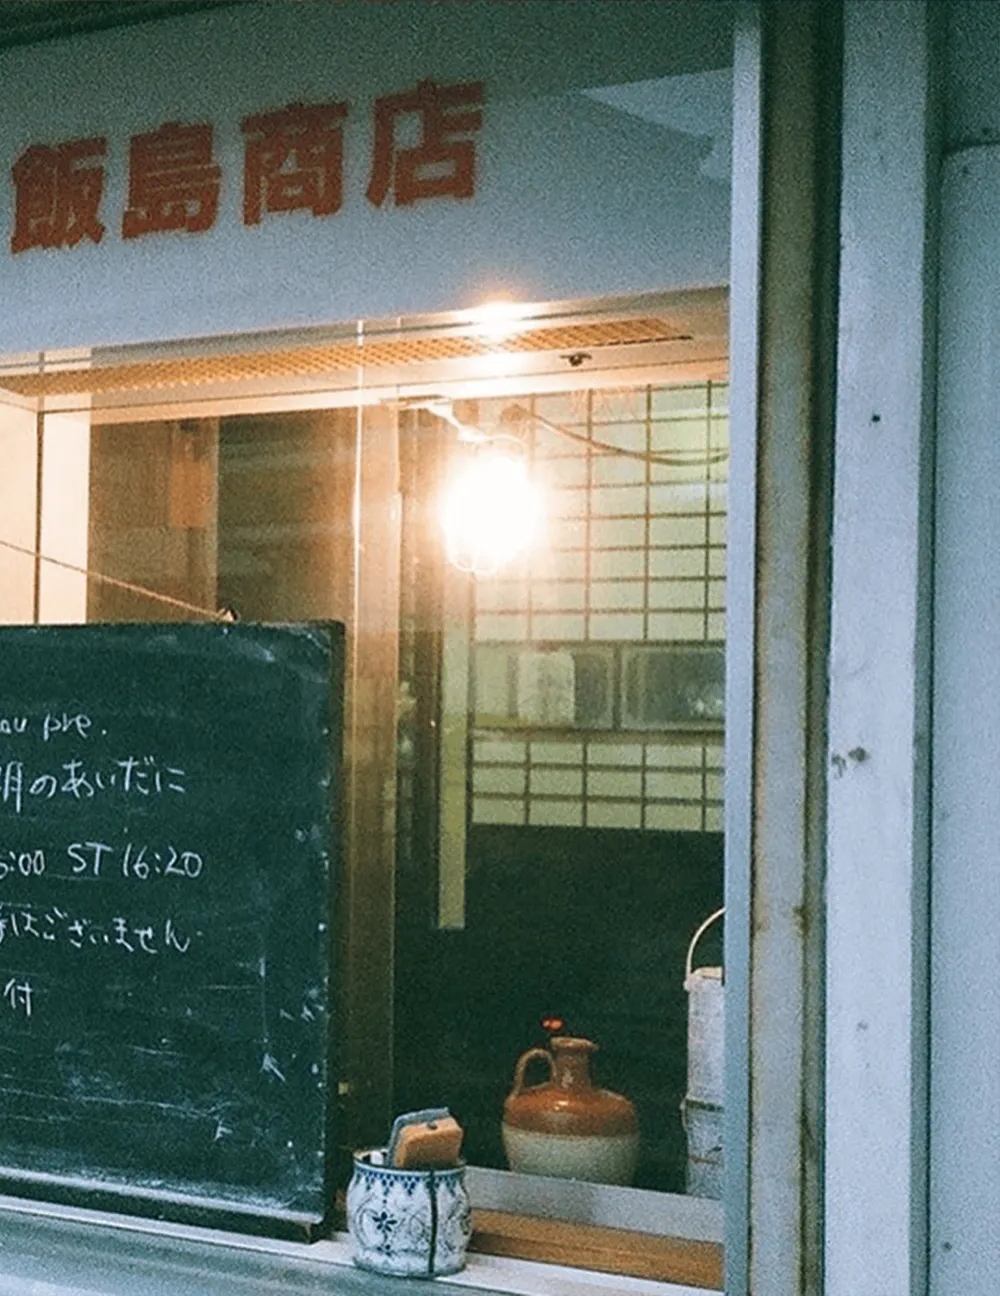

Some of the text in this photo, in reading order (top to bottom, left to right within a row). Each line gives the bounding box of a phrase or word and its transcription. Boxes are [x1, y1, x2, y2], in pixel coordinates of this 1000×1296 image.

[11, 79, 485, 255] 飯島商店
[67, 843, 113, 876] ST
[123, 842, 203, 879] 16:20
